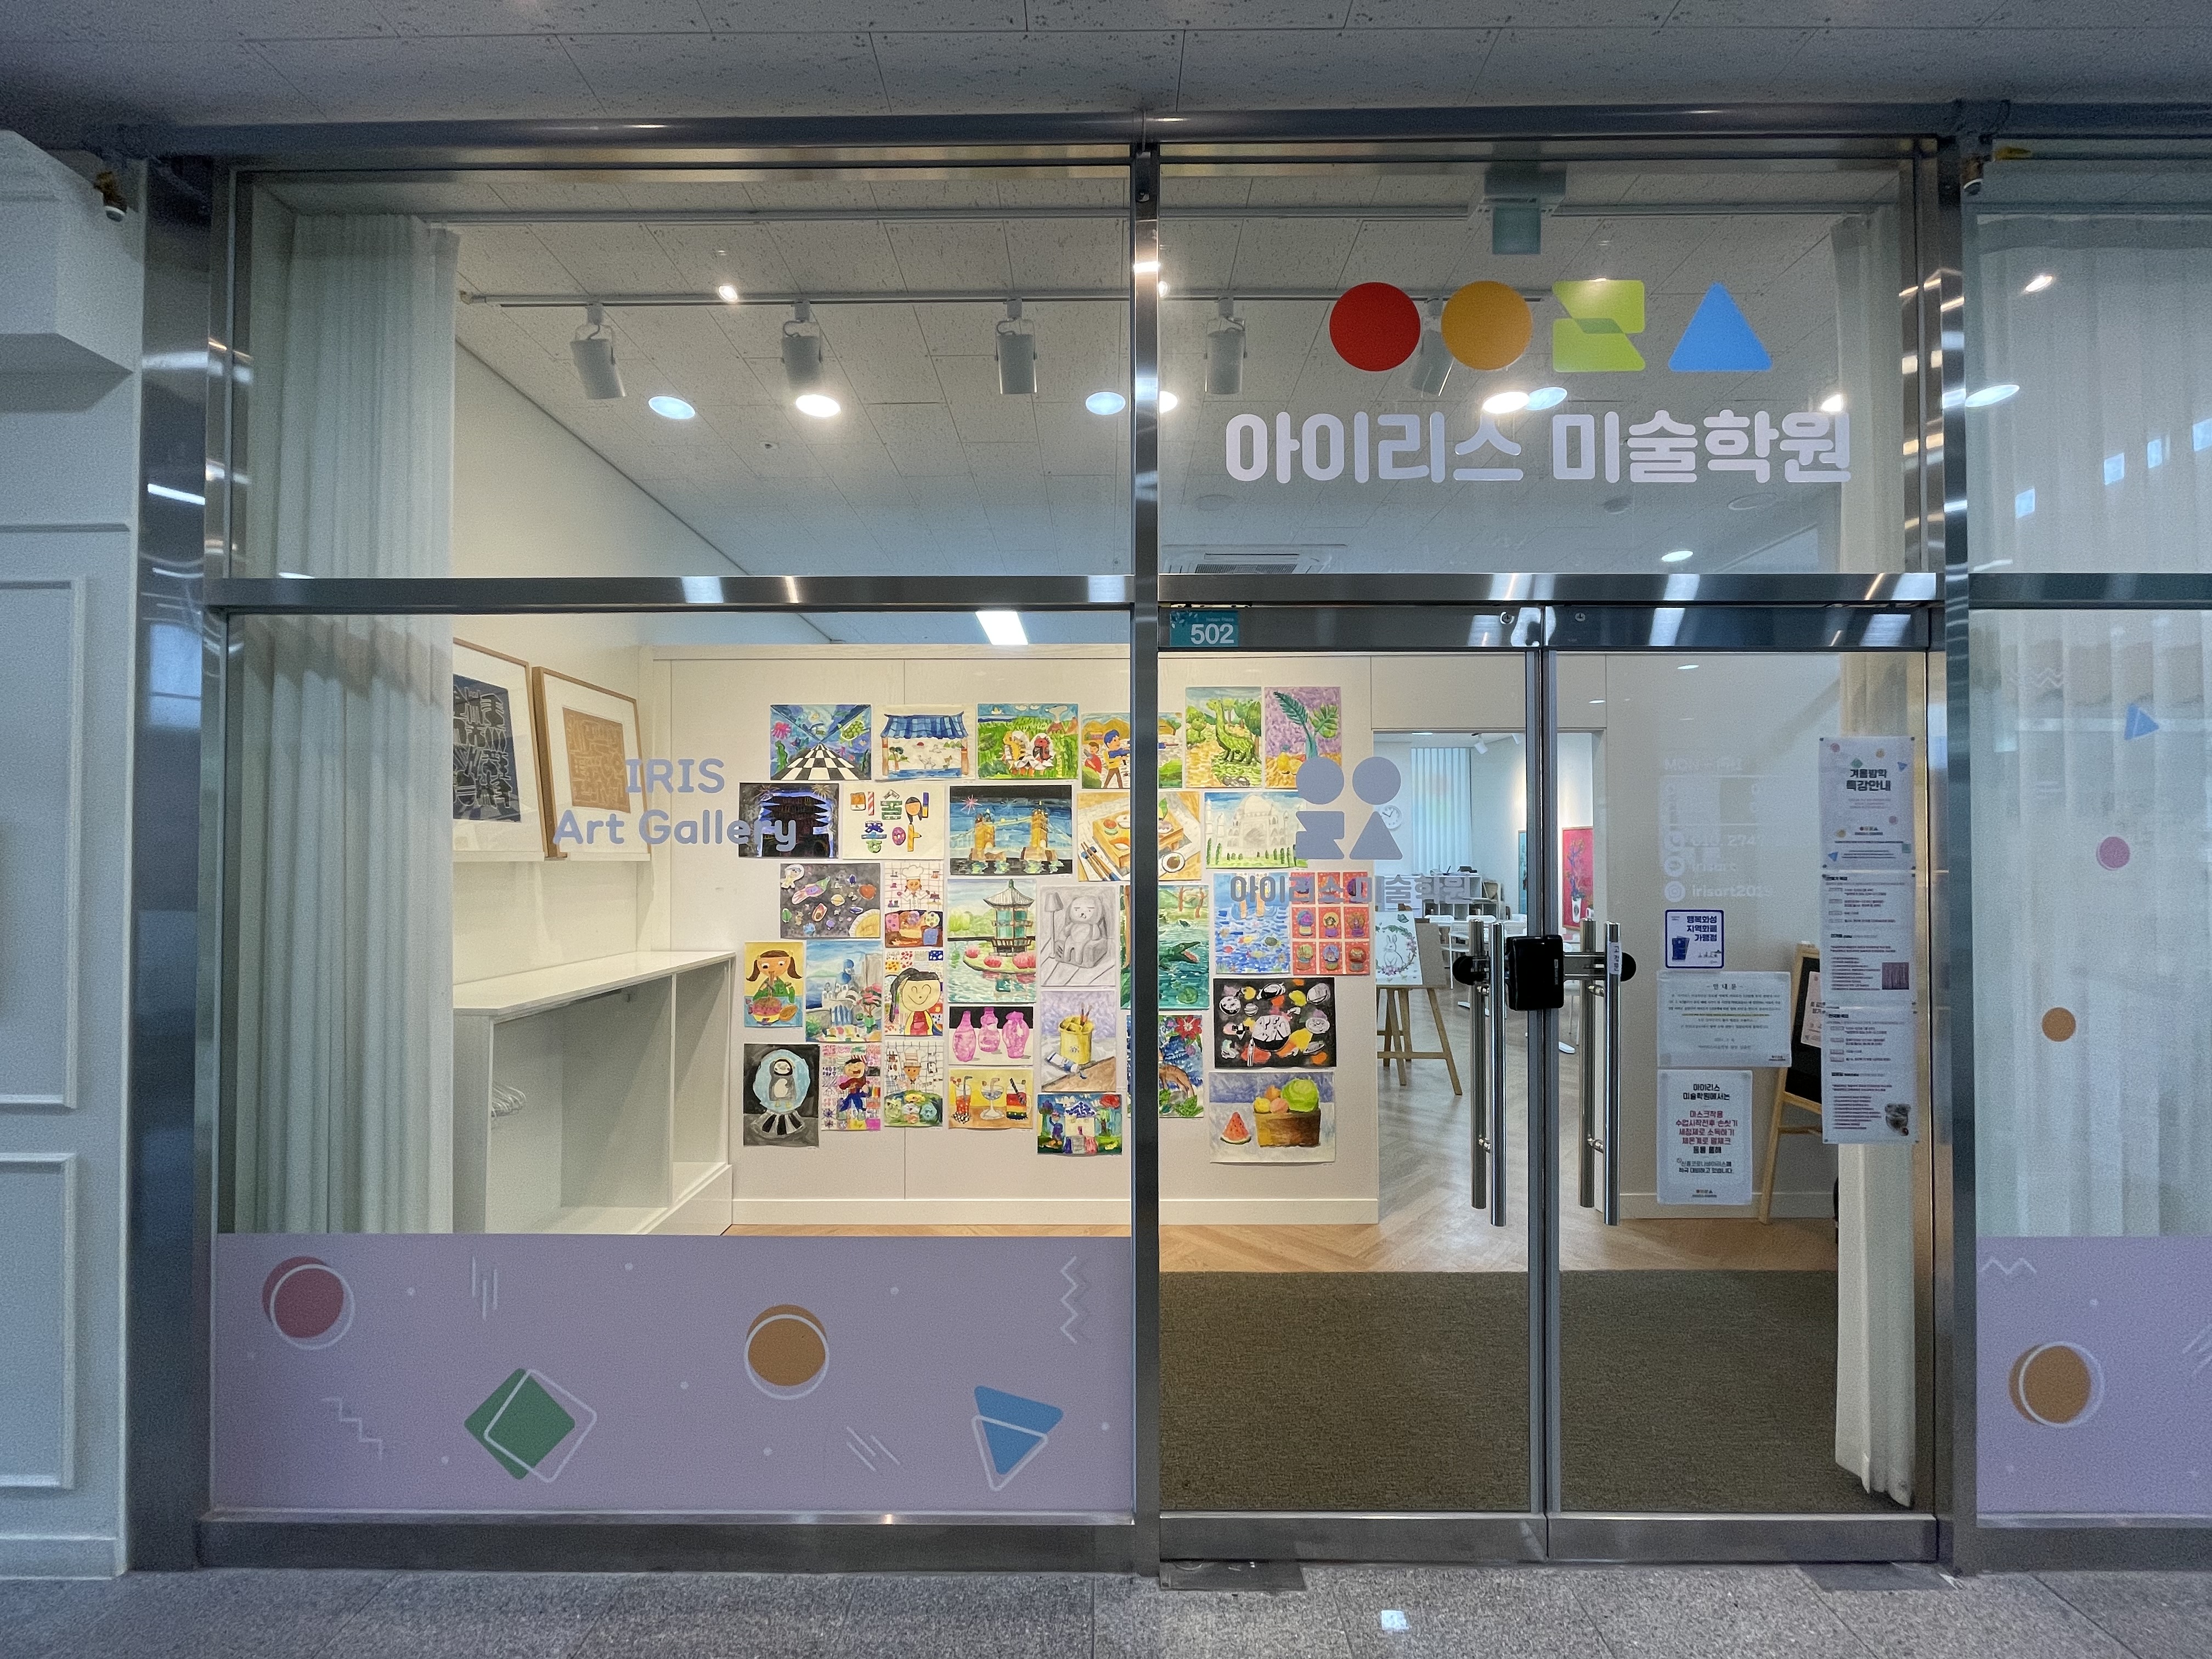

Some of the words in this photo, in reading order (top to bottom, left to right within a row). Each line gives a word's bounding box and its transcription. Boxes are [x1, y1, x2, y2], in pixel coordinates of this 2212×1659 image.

[1226, 411, 1524, 483] 아이리스
[1551, 409, 1851, 483] 미술학원
[1190, 623, 1234, 645] 502
[625, 758, 725, 794] IRIS
[1847, 780, 1891, 791] 특강안내
[1850, 769, 1887, 778] 겨울방학
[552, 809, 625, 845] Art
[639, 809, 797, 852] Gallery
[1231, 875, 1345, 903] 아이리스
[1355, 872, 1472, 904] 미술학원
